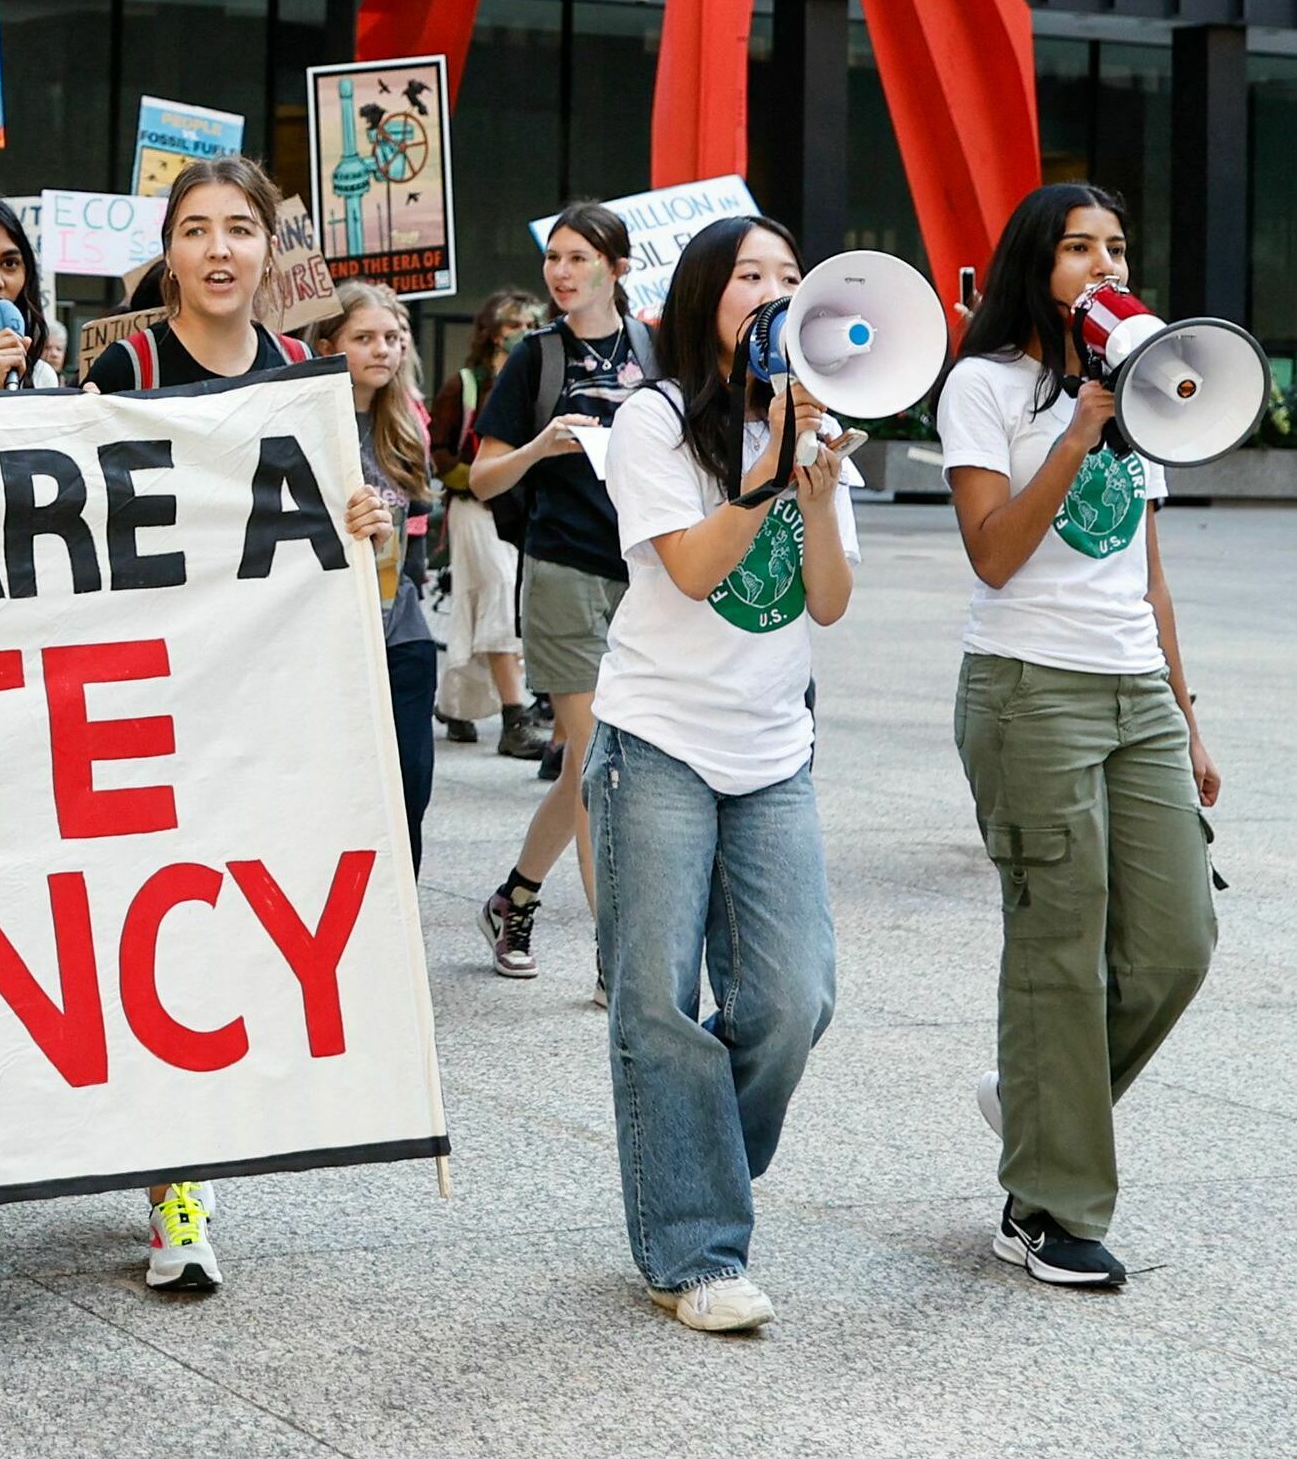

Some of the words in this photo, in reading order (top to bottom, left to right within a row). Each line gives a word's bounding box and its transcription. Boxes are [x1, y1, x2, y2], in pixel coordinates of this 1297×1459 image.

[140, 131, 189, 152] FOSSIL
[54, 194, 135, 231] ECO
[330, 260, 360, 279] END
[363, 257, 389, 274] THE
[392, 254, 420, 272] ERA
[423, 250, 443, 268] OF
[392, 271, 435, 292] FUELS
[237, 434, 350, 580] A
[1099, 535, 1127, 554] U.S.
[758, 608, 789, 628] U.S.
